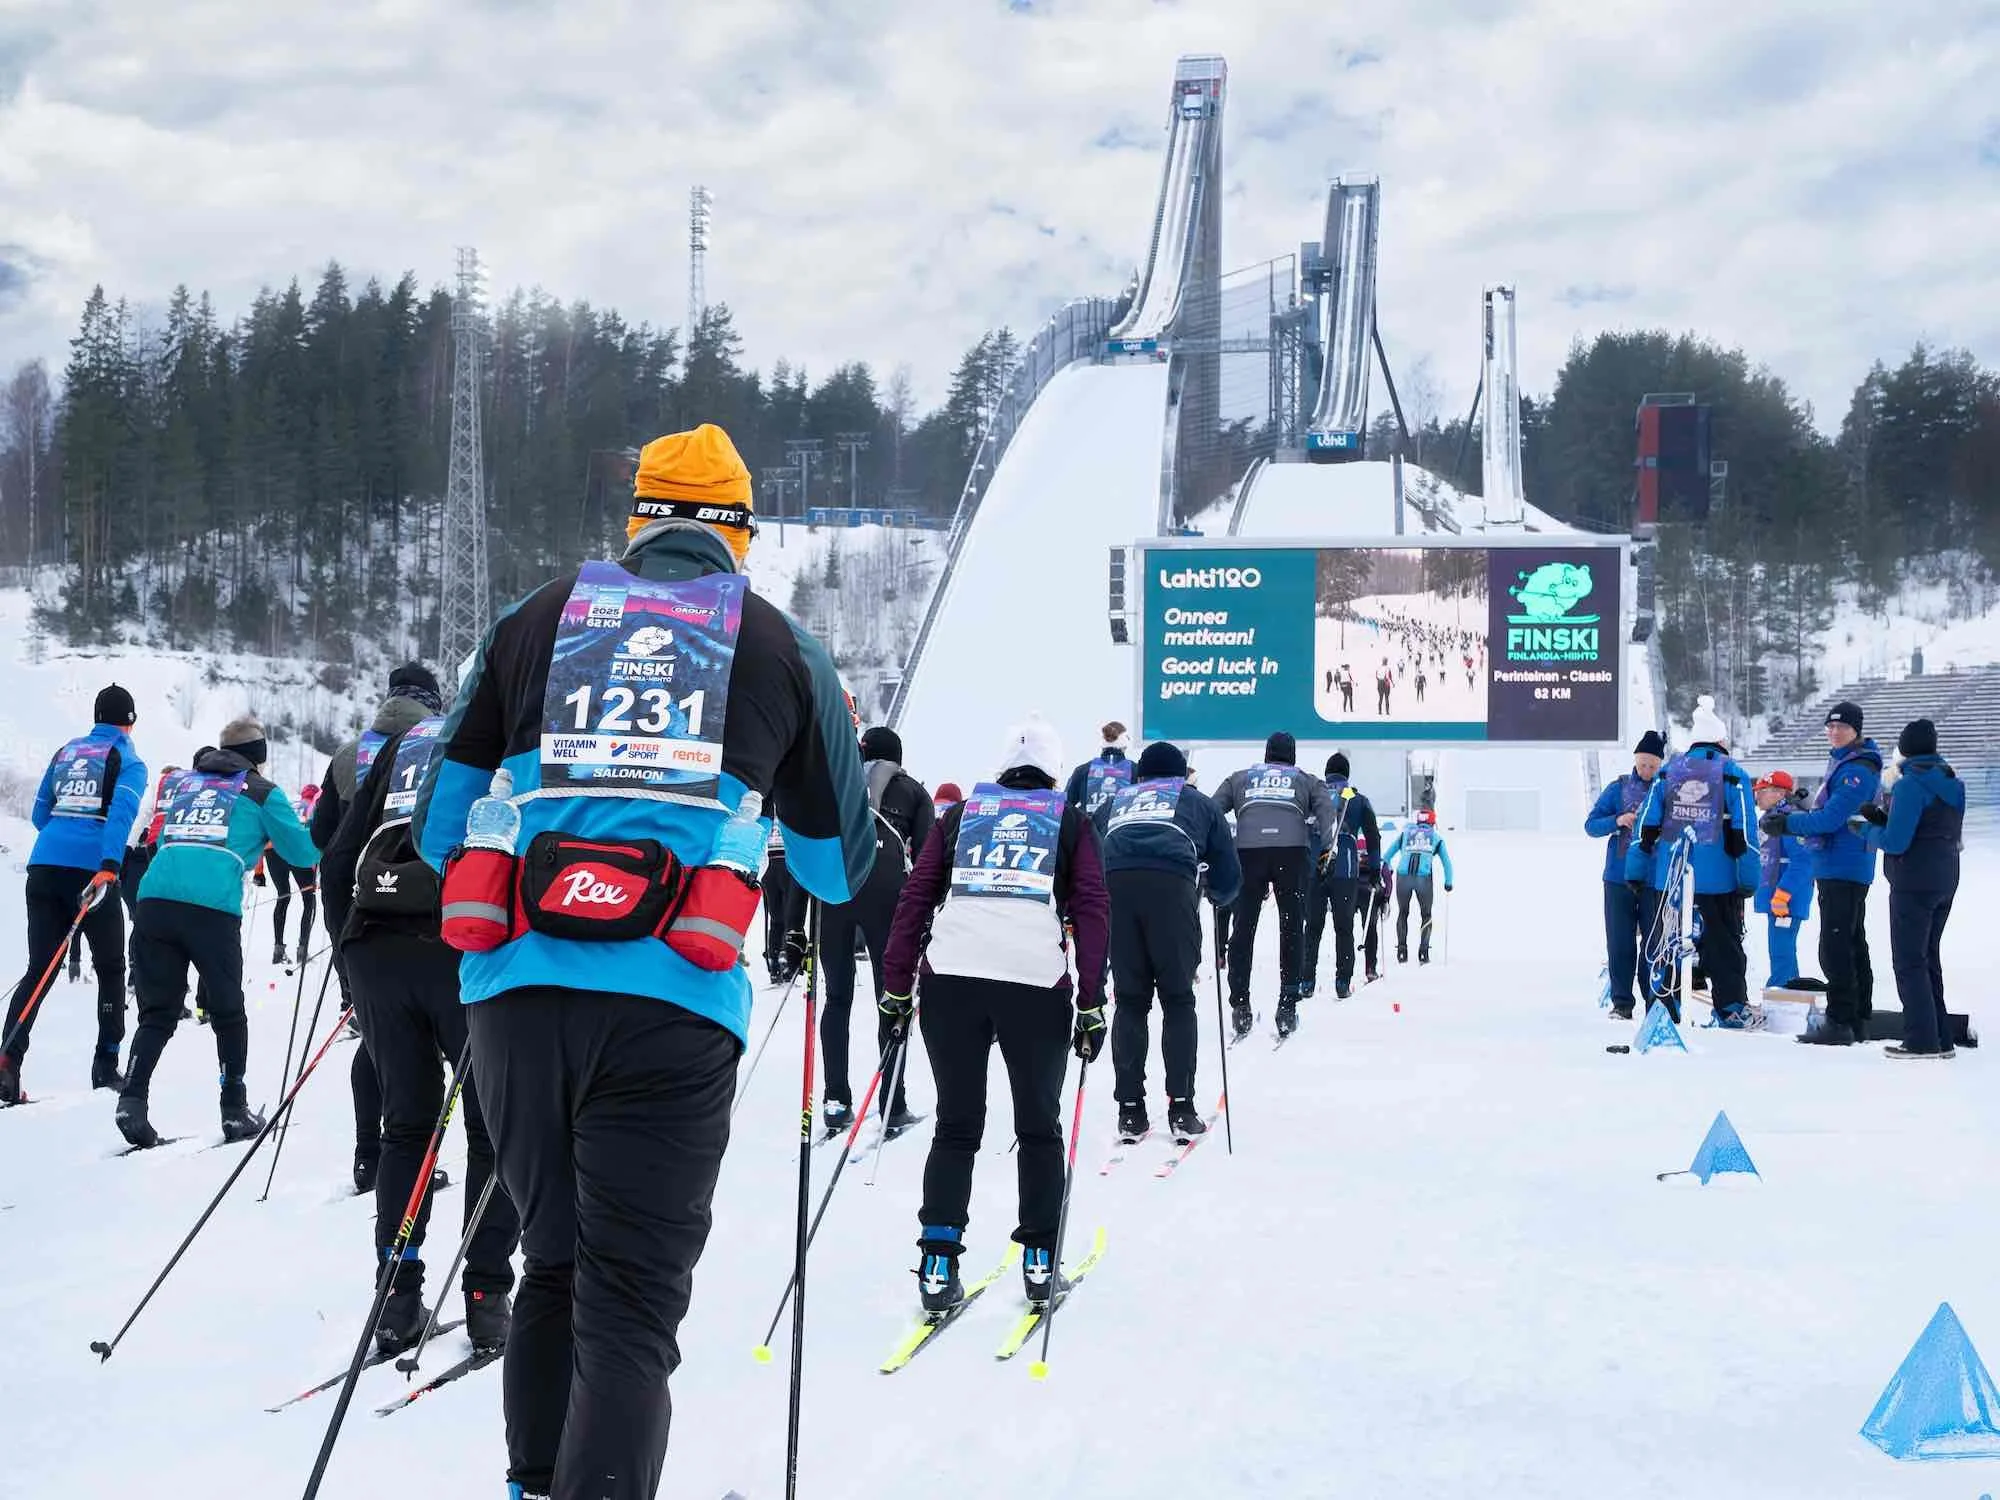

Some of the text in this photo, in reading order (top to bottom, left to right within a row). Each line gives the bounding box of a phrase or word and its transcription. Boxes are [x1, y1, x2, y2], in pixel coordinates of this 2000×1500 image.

[637, 502, 675, 515] BITS
[696, 507, 743, 522] BITS
[1160, 568, 1261, 588] Lahti120
[592, 607, 620, 616] 2025
[1164, 608, 1228, 625] Onnea
[586, 618, 621, 628] 62 KM
[1164, 628, 1255, 645] matkaan!
[1508, 628, 1598, 651] FINSKI
[1508, 652, 1598, 660] FINLANDIA-HIIHTO
[611, 661, 674, 676] FINSKI
[1162, 656, 1279, 674] Good luck in
[1569, 670, 1612, 682] Classic
[1160, 678, 1257, 699] your race!
[1534, 688, 1571, 699] 62 KM
[566, 685, 705, 735] 1231
[553, 739, 597, 749] VITAMIN
[629, 743, 660, 752] INTER
[553, 749, 579, 758] WELL
[628, 751, 659, 760] SPORT
[672, 749, 711, 763] renta
[593, 768, 664, 780] SALOMON
[1251, 776, 1292, 788] 1409
[175, 808, 225, 825] 1452
[1672, 806, 1711, 818] FINSKI
[992, 831, 1028, 839] FINSKI
[967, 844, 1049, 871] 1477
[561, 869, 628, 906] Rex
